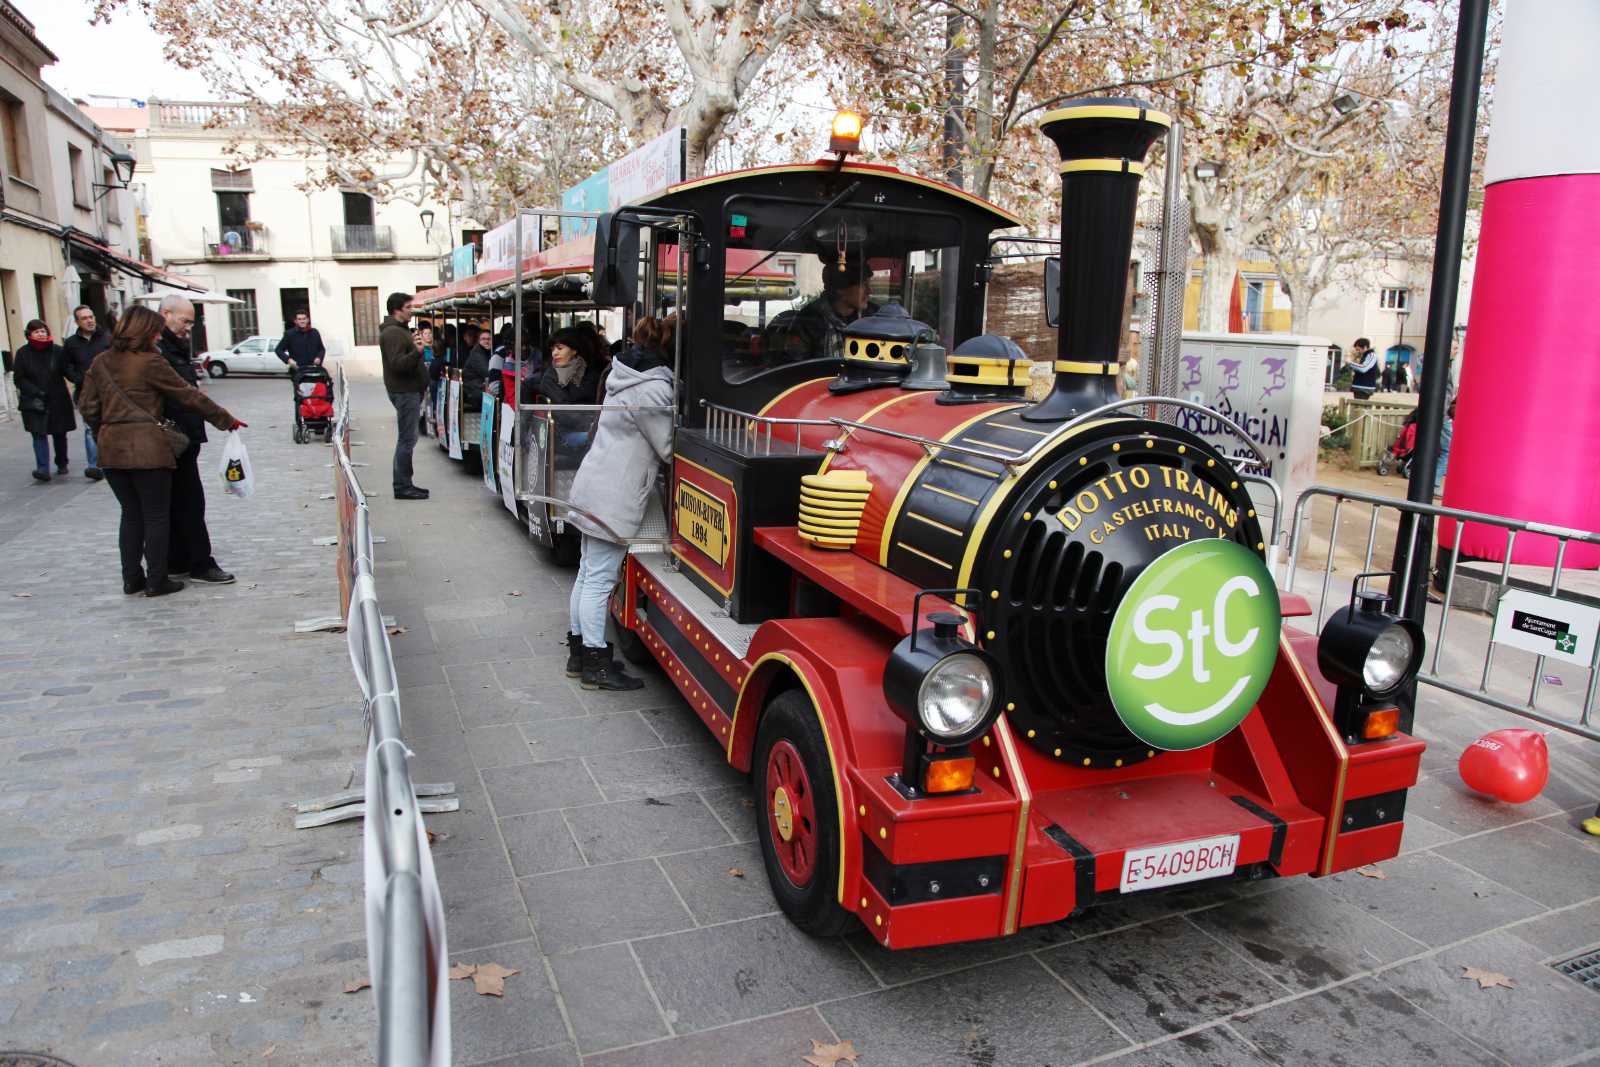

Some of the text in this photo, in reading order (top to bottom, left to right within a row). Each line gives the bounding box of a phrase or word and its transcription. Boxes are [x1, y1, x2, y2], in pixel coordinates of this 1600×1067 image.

[1056, 465, 1238, 533] DOTTO TRAINS
[691, 520, 708, 546] 1894
[1089, 498, 1216, 545] CASTELFRANCO
[1143, 523, 1190, 541] ITALY
[1131, 575, 1260, 684] StC
[1524, 616, 1556, 629] Ajuntament
